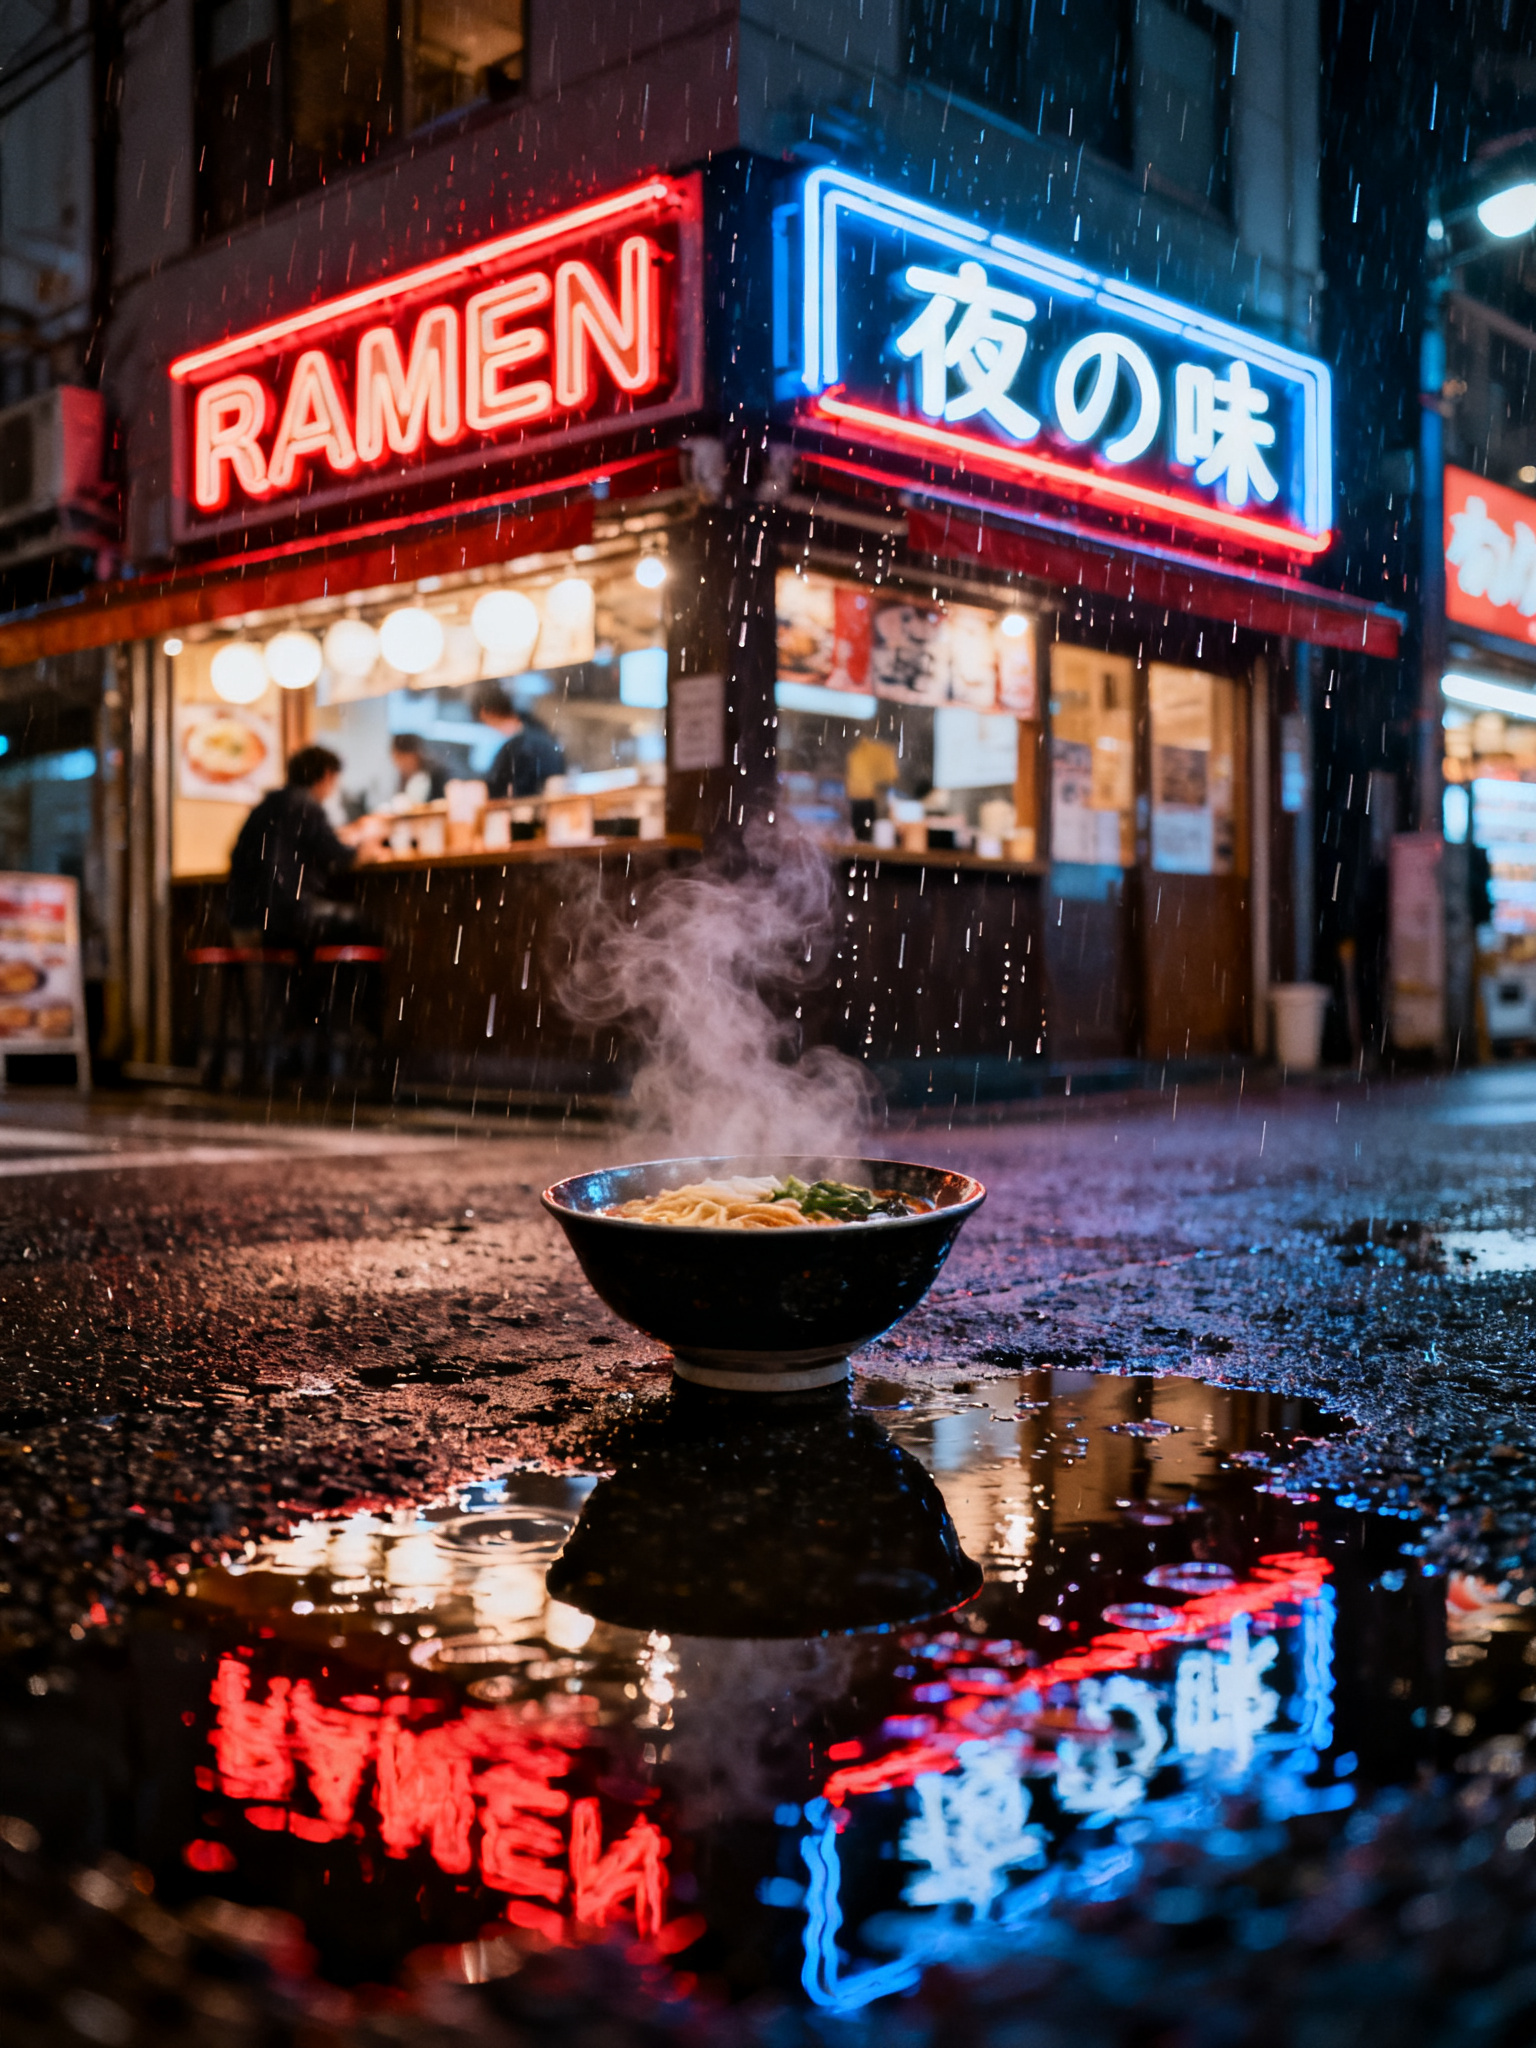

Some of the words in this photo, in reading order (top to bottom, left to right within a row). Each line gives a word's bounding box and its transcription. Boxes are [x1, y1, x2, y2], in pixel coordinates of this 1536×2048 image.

[194, 235, 659, 508] RAMEN
[895, 260, 1280, 506] 夜の味
